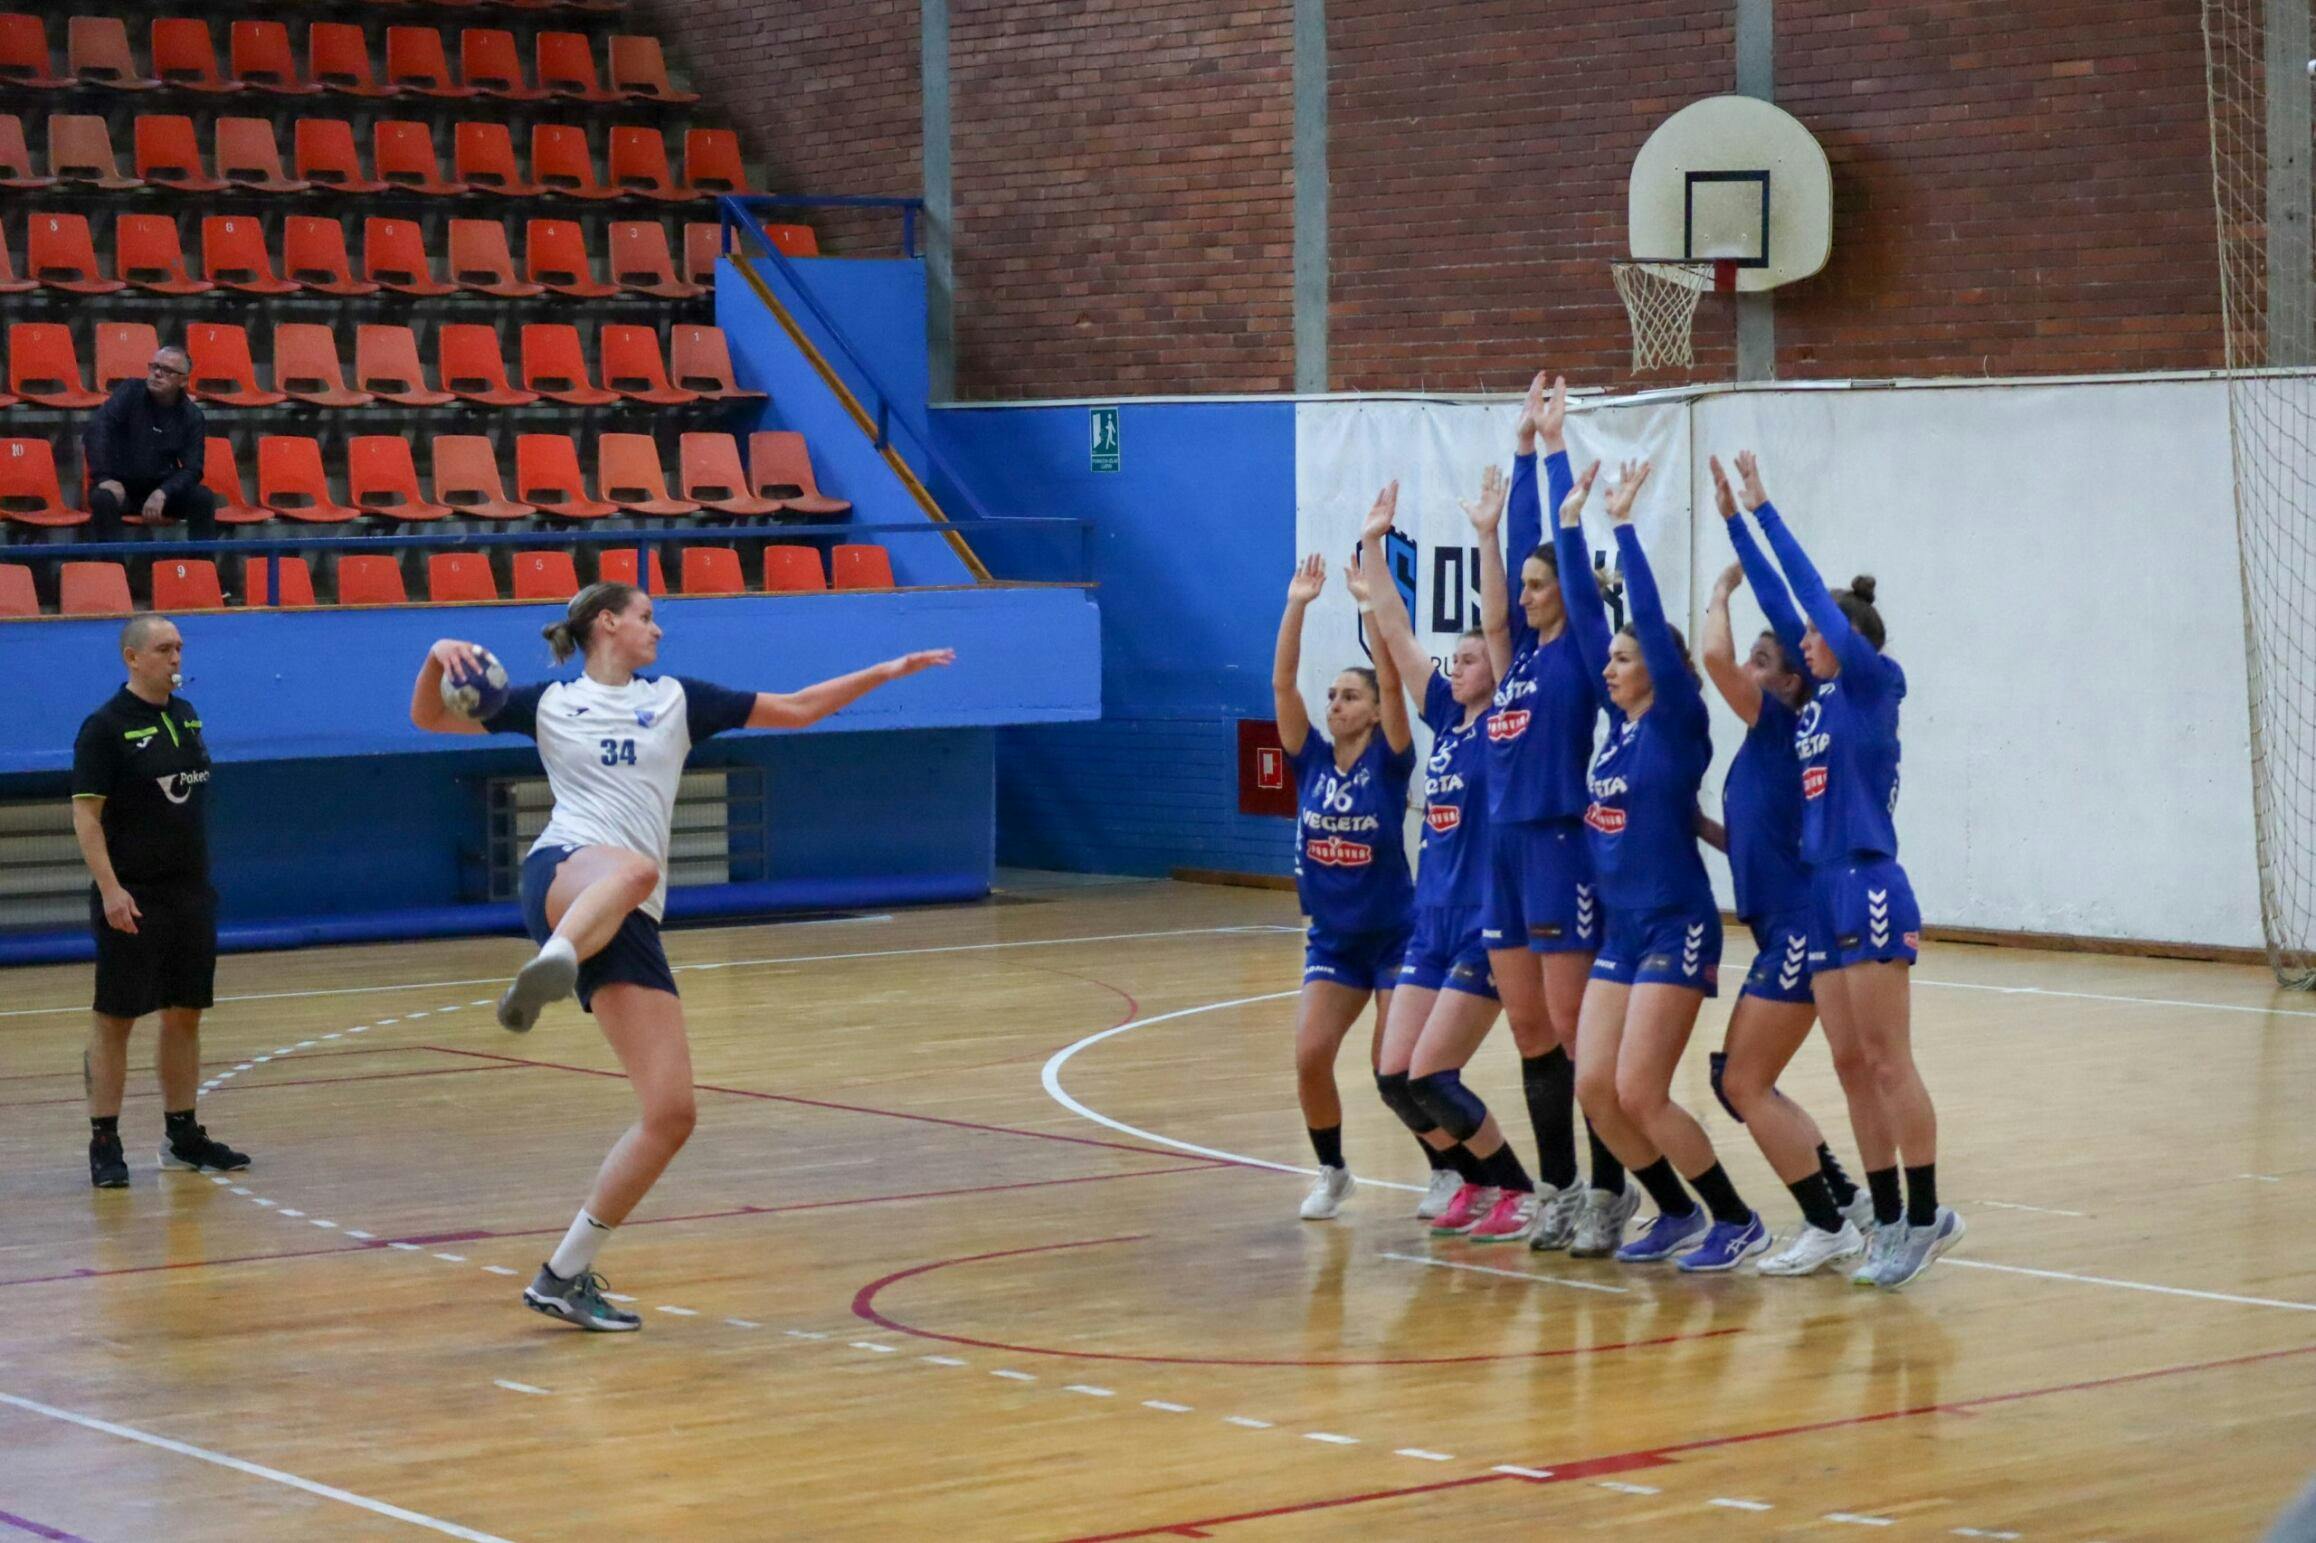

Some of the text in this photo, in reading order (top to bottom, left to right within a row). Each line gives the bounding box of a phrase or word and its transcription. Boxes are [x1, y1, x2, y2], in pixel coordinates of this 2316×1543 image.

[546, 226, 556, 238] 4
[630, 227, 639, 239] 3
[11, 443, 24, 457] 10
[176, 564, 186, 579] 9
[535, 558, 544, 571] 5
[600, 738, 637, 766] 34
[1322, 777, 1353, 813] 96
[1302, 807, 1380, 833] VEGETA
